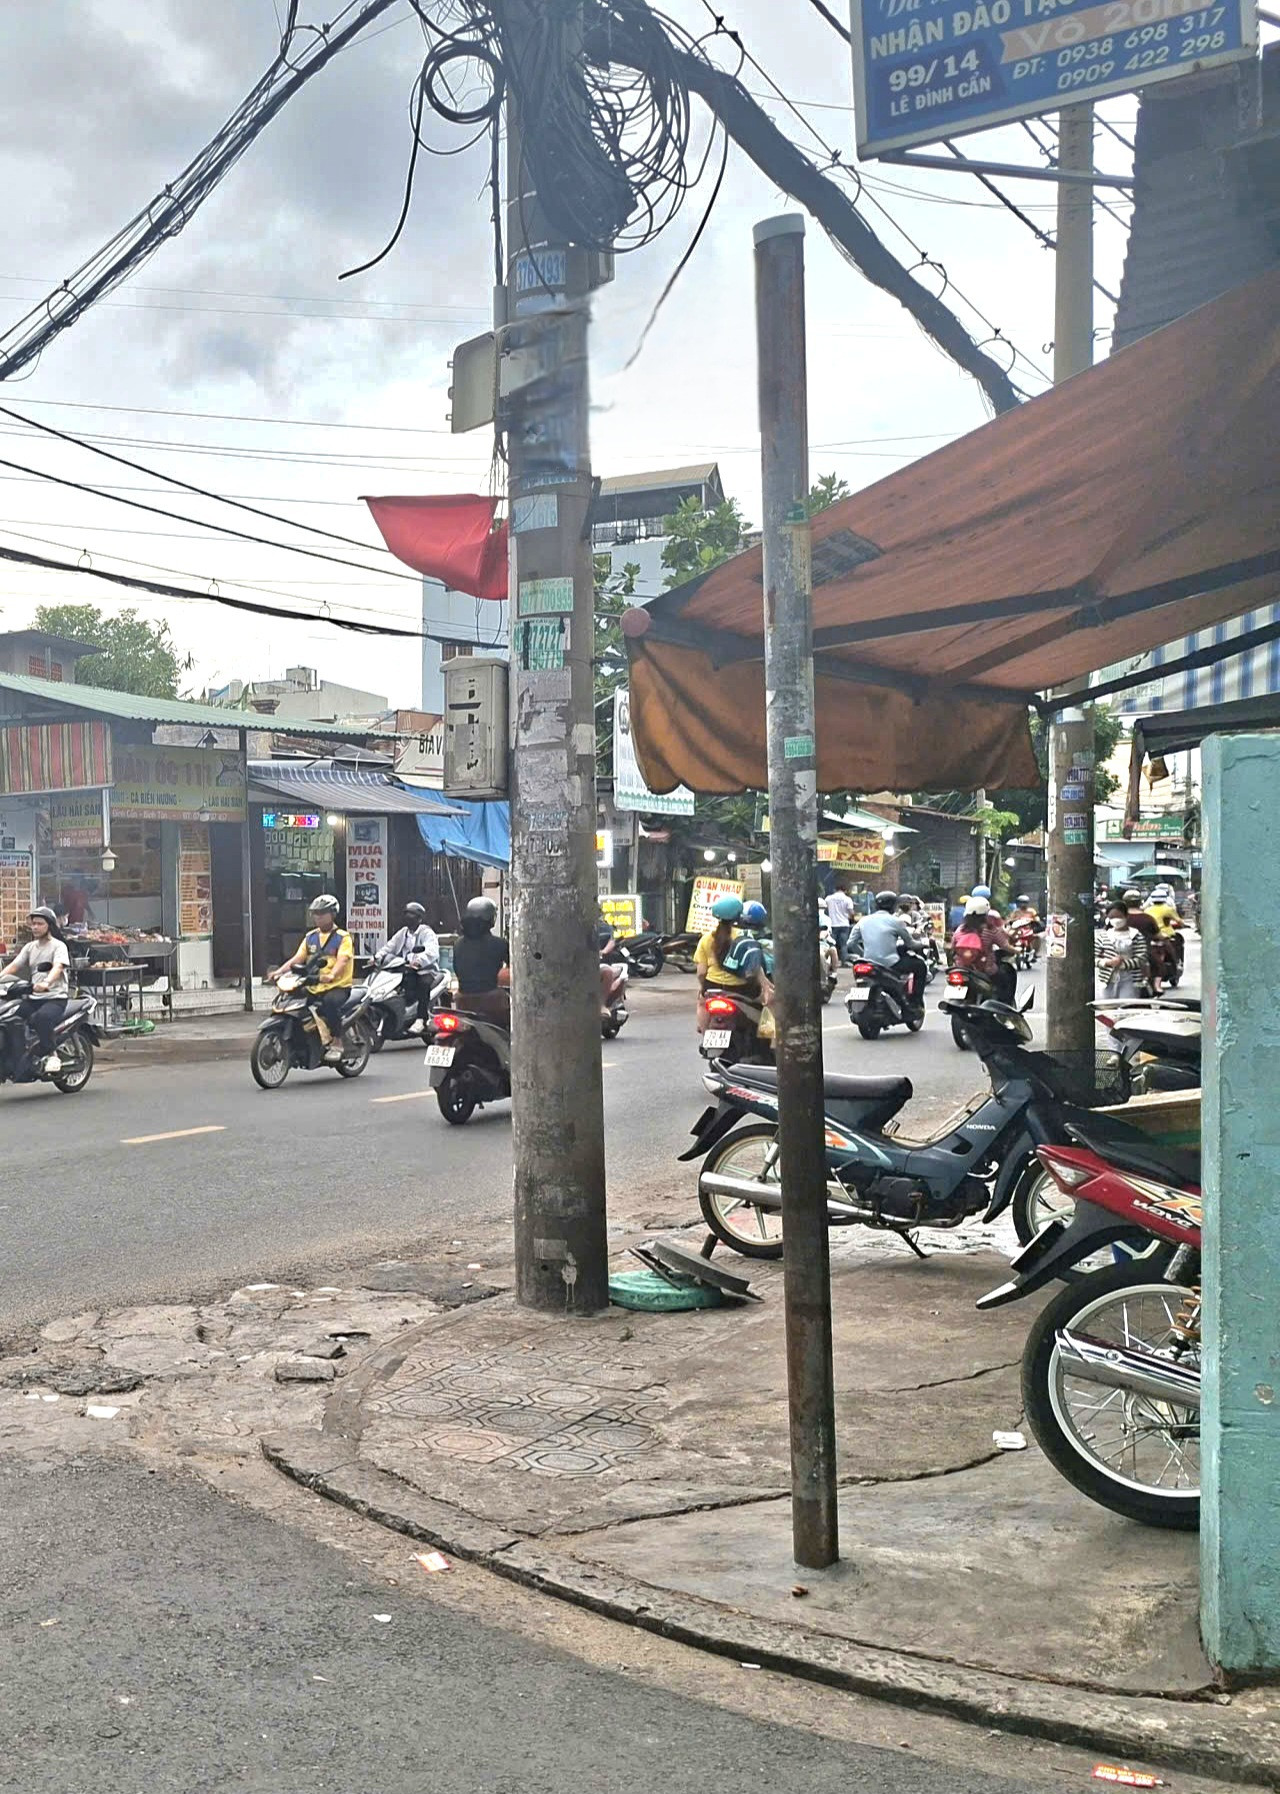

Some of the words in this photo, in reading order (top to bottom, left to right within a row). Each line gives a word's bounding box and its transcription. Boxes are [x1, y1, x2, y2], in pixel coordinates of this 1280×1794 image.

[870, 17, 945, 60] NHẬN
[952, 0, 1012, 37] ĐÀO
[1013, 57, 1047, 80] ĐT:
[1057, 37, 1113, 67] 0938
[1124, 22, 1168, 49] 698
[1179, 7, 1226, 34] 317
[889, 49, 980, 92] 99/14
[1057, 61, 1115, 89] 0909
[1124, 46, 1169, 71] 422
[1180, 31, 1225, 57] 298
[890, 95, 910, 117] LÊ
[915, 87, 953, 110] ĐÌNH
[958, 71, 992, 98] CẨN
[348, 845, 383, 855] MUA
[348, 857, 382, 869] BÁN
[354, 872, 376, 882] PC
